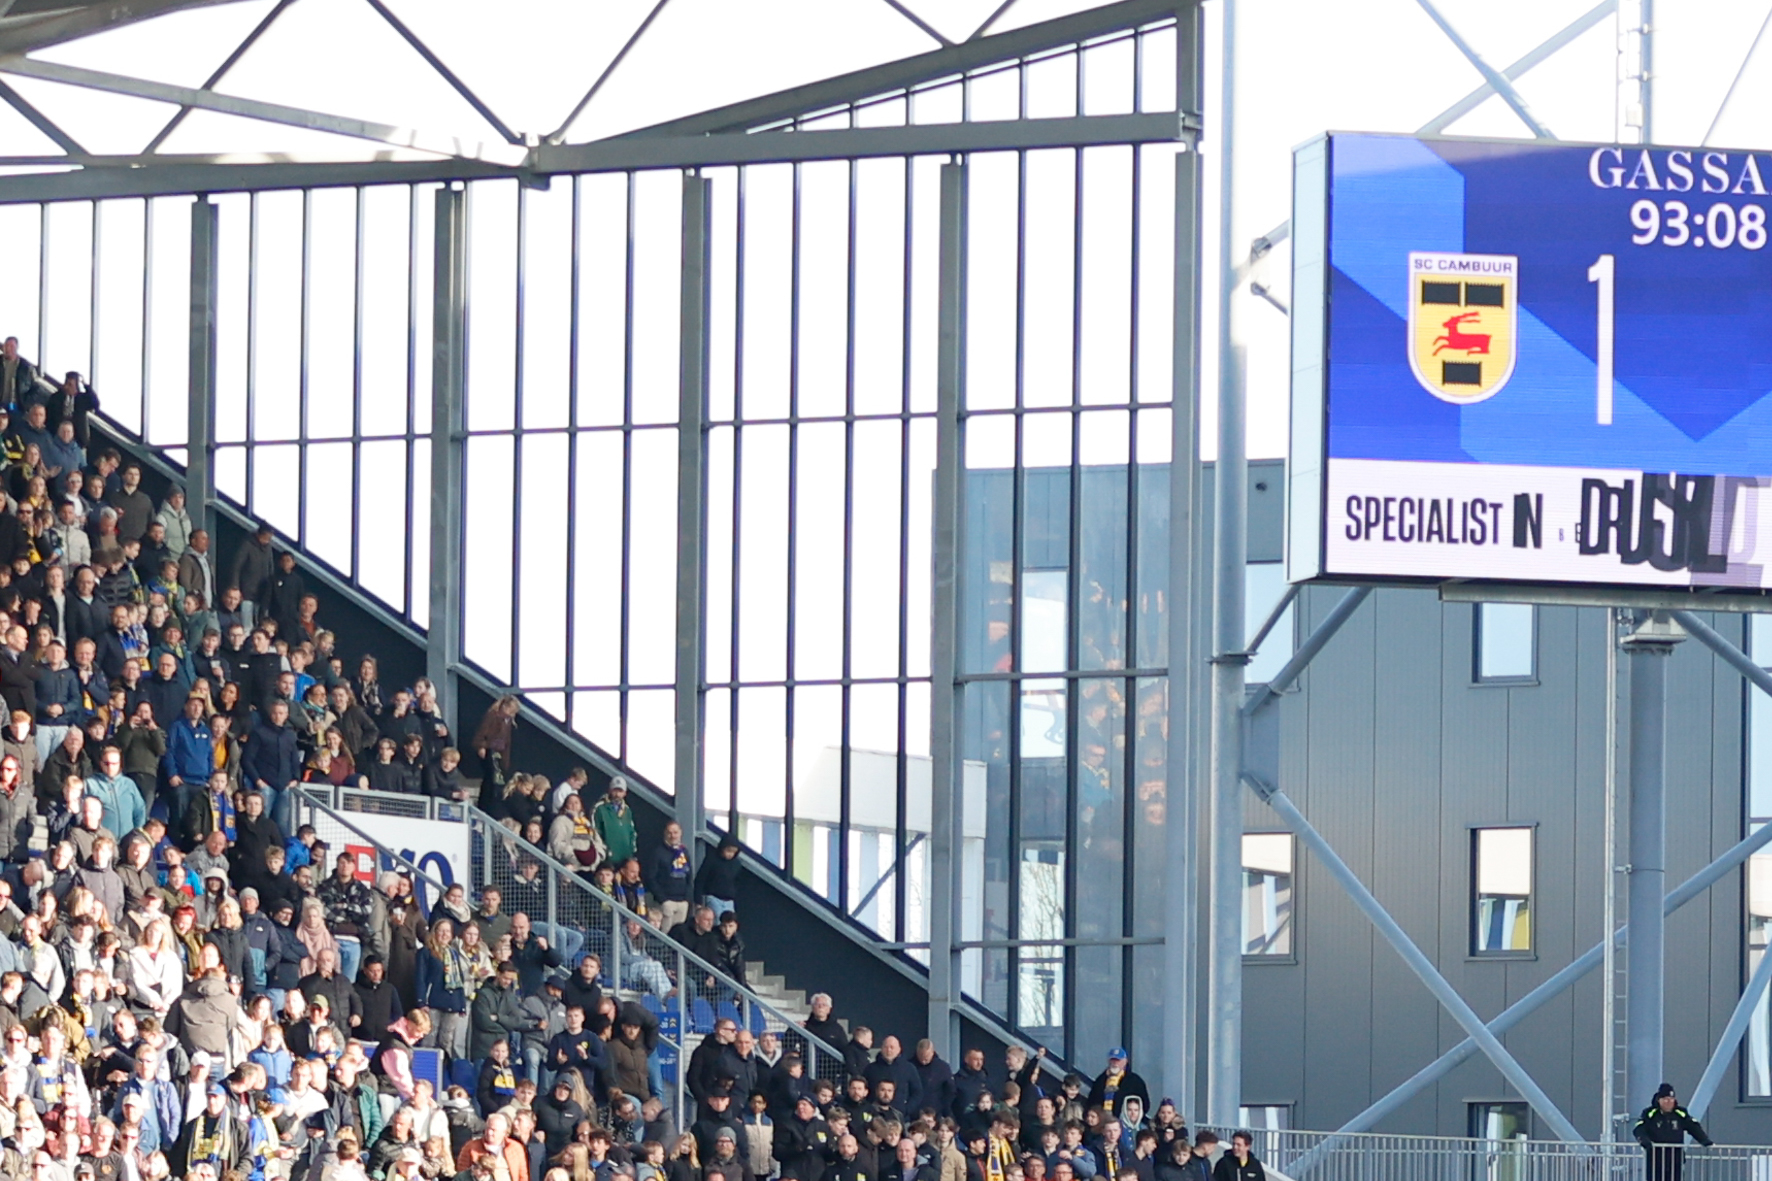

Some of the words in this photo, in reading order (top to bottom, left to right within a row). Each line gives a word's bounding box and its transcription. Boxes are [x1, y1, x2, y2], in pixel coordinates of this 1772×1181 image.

[1630, 199, 1767, 250] 93:08
[1414, 258, 1433, 270] SC
[1438, 259, 1512, 273] CAMBUUR
[1588, 254, 1614, 426] 1
[1345, 494, 1503, 546] SPECIALIST
